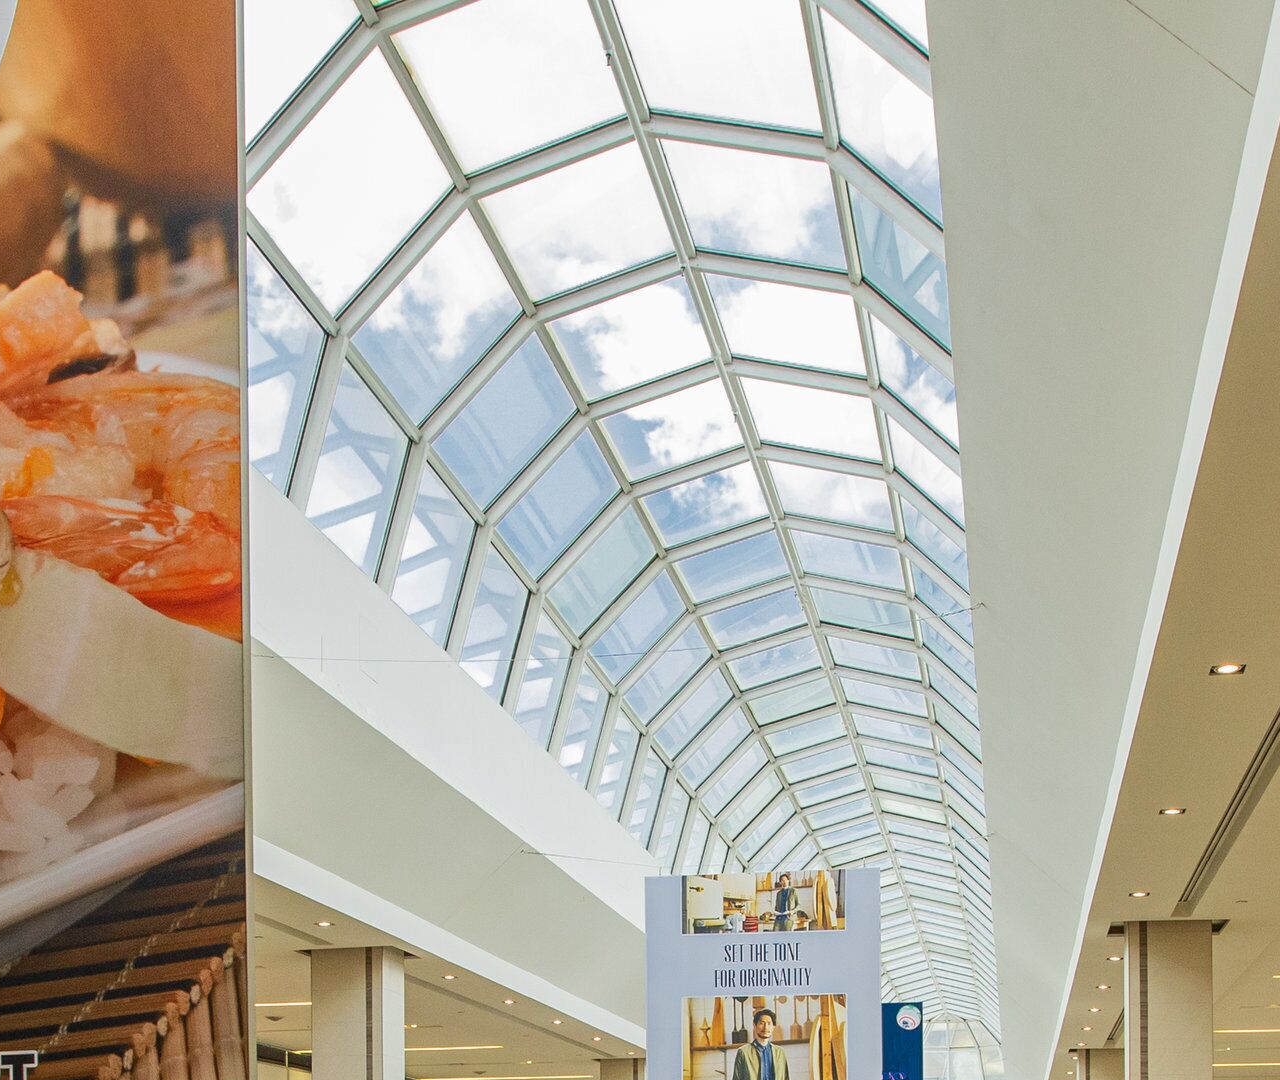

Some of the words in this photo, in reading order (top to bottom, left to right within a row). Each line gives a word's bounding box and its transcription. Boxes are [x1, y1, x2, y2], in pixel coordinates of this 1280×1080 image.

[724, 943, 743, 962] SET
[749, 943, 768, 962] THE
[773, 942, 801, 961] TONE
[714, 969, 736, 988] FOR
[740, 967, 812, 987] ORIGINALITY
